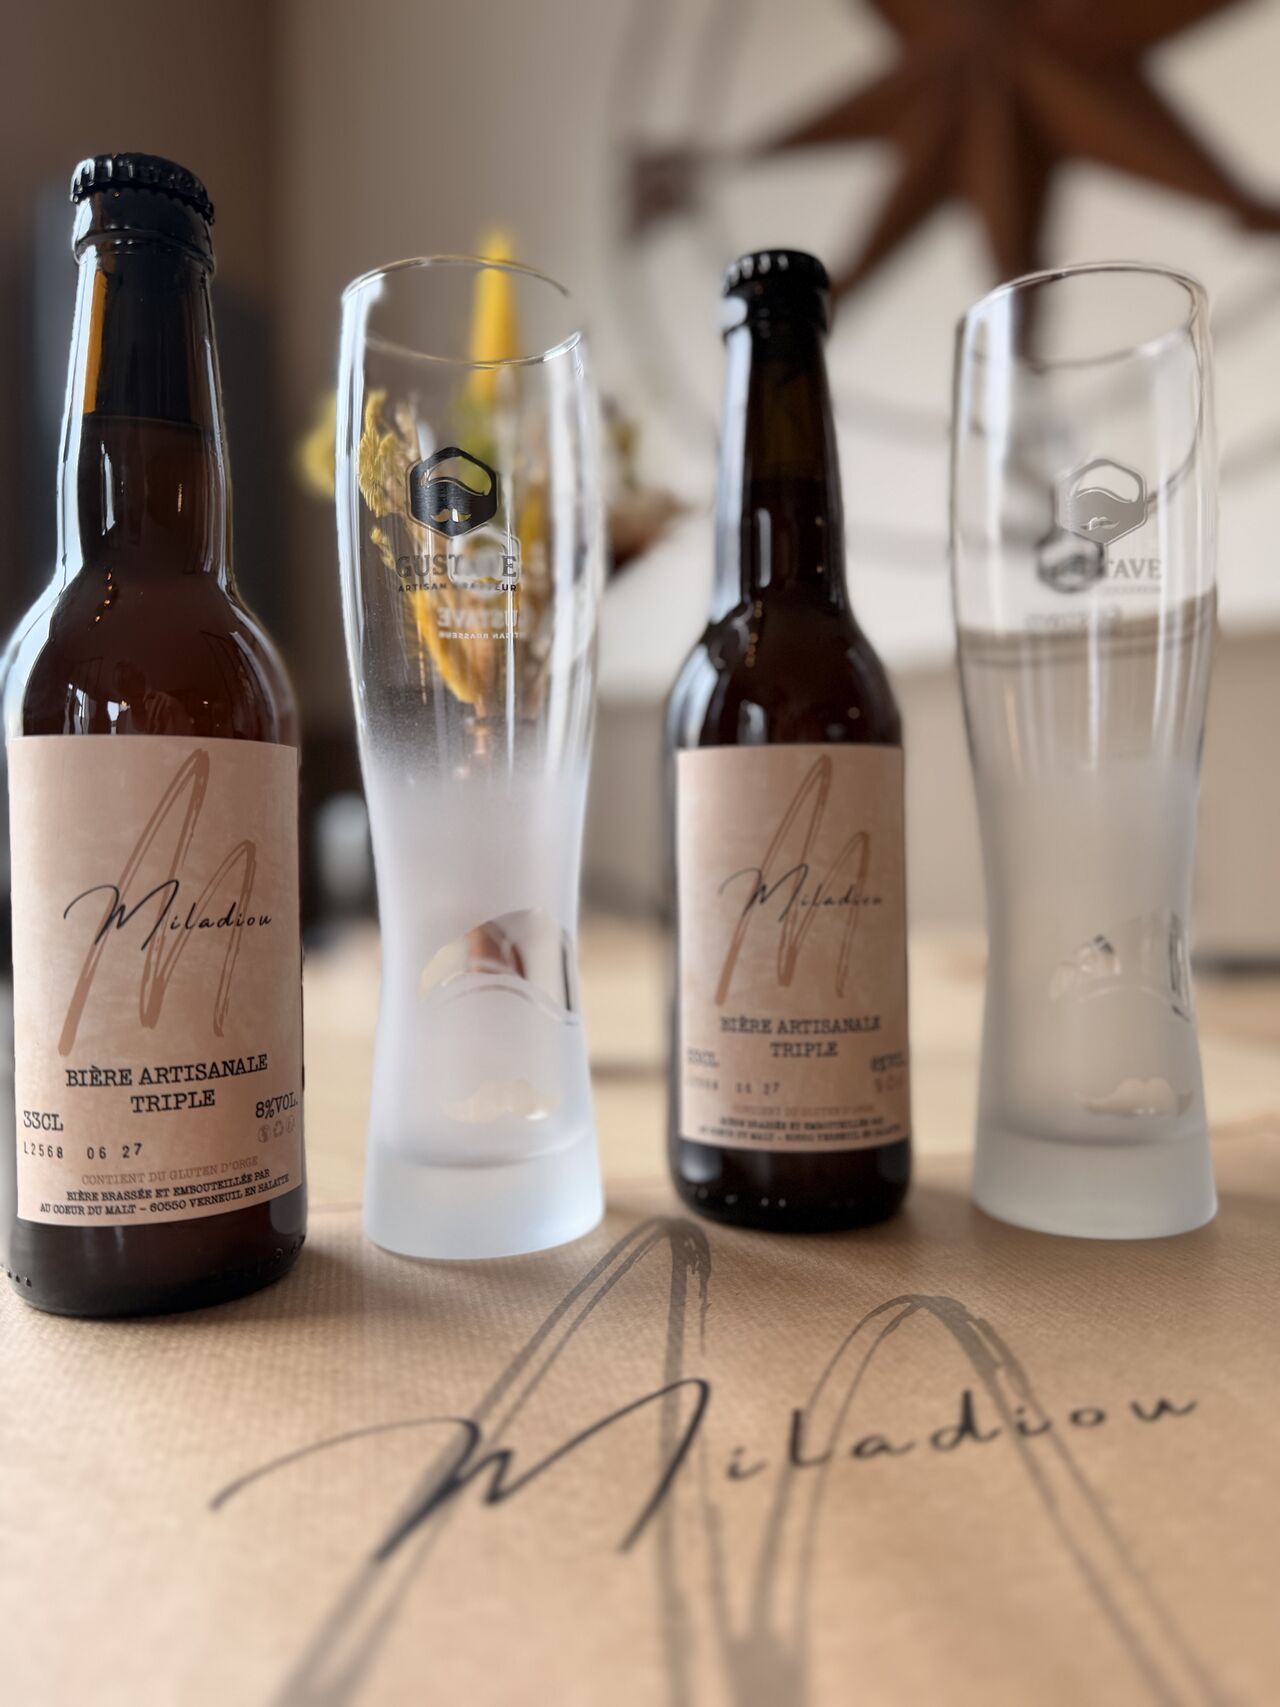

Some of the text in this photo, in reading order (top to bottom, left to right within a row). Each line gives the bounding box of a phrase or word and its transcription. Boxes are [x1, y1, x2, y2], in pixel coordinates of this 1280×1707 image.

[396, 554, 516, 577] GUSTE
[398, 584, 447, 593] ARTISAN
[63, 879, 273, 951] Miladiou
[770, 1041, 838, 1057] TRIPLE
[65, 1053, 268, 1088] BIÈRE ARTISANALE
[130, 1089, 216, 1113] TRIPLE
[23, 1111, 64, 1132] 33CL
[23, 1142, 142, 1160] L2568 06 27
[81, 1173, 145, 1185] CONTIENT
[149, 1171, 166, 1183] DU
[169, 1163, 218, 1181] GLUTEN
[66, 1189, 98, 1201] BIÈRE
[101, 1188, 152, 1201] BRASSÉE
[155, 1188, 170, 1199] ET
[173, 1173, 252, 1197] EMBOUTEILLÉE
[40, 1202, 51, 1213] AU
[53, 1203, 85, 1216] COEUR
[88, 1204, 102, 1216] DU
[105, 1203, 136, 1216] MALT
[150, 1199, 187, 1213] 60550
[189, 1190, 243, 1209] VERNEUIL
[245, 1186, 257, 1197] EN
[208, 1377, 1197, 1563] Miladiou
